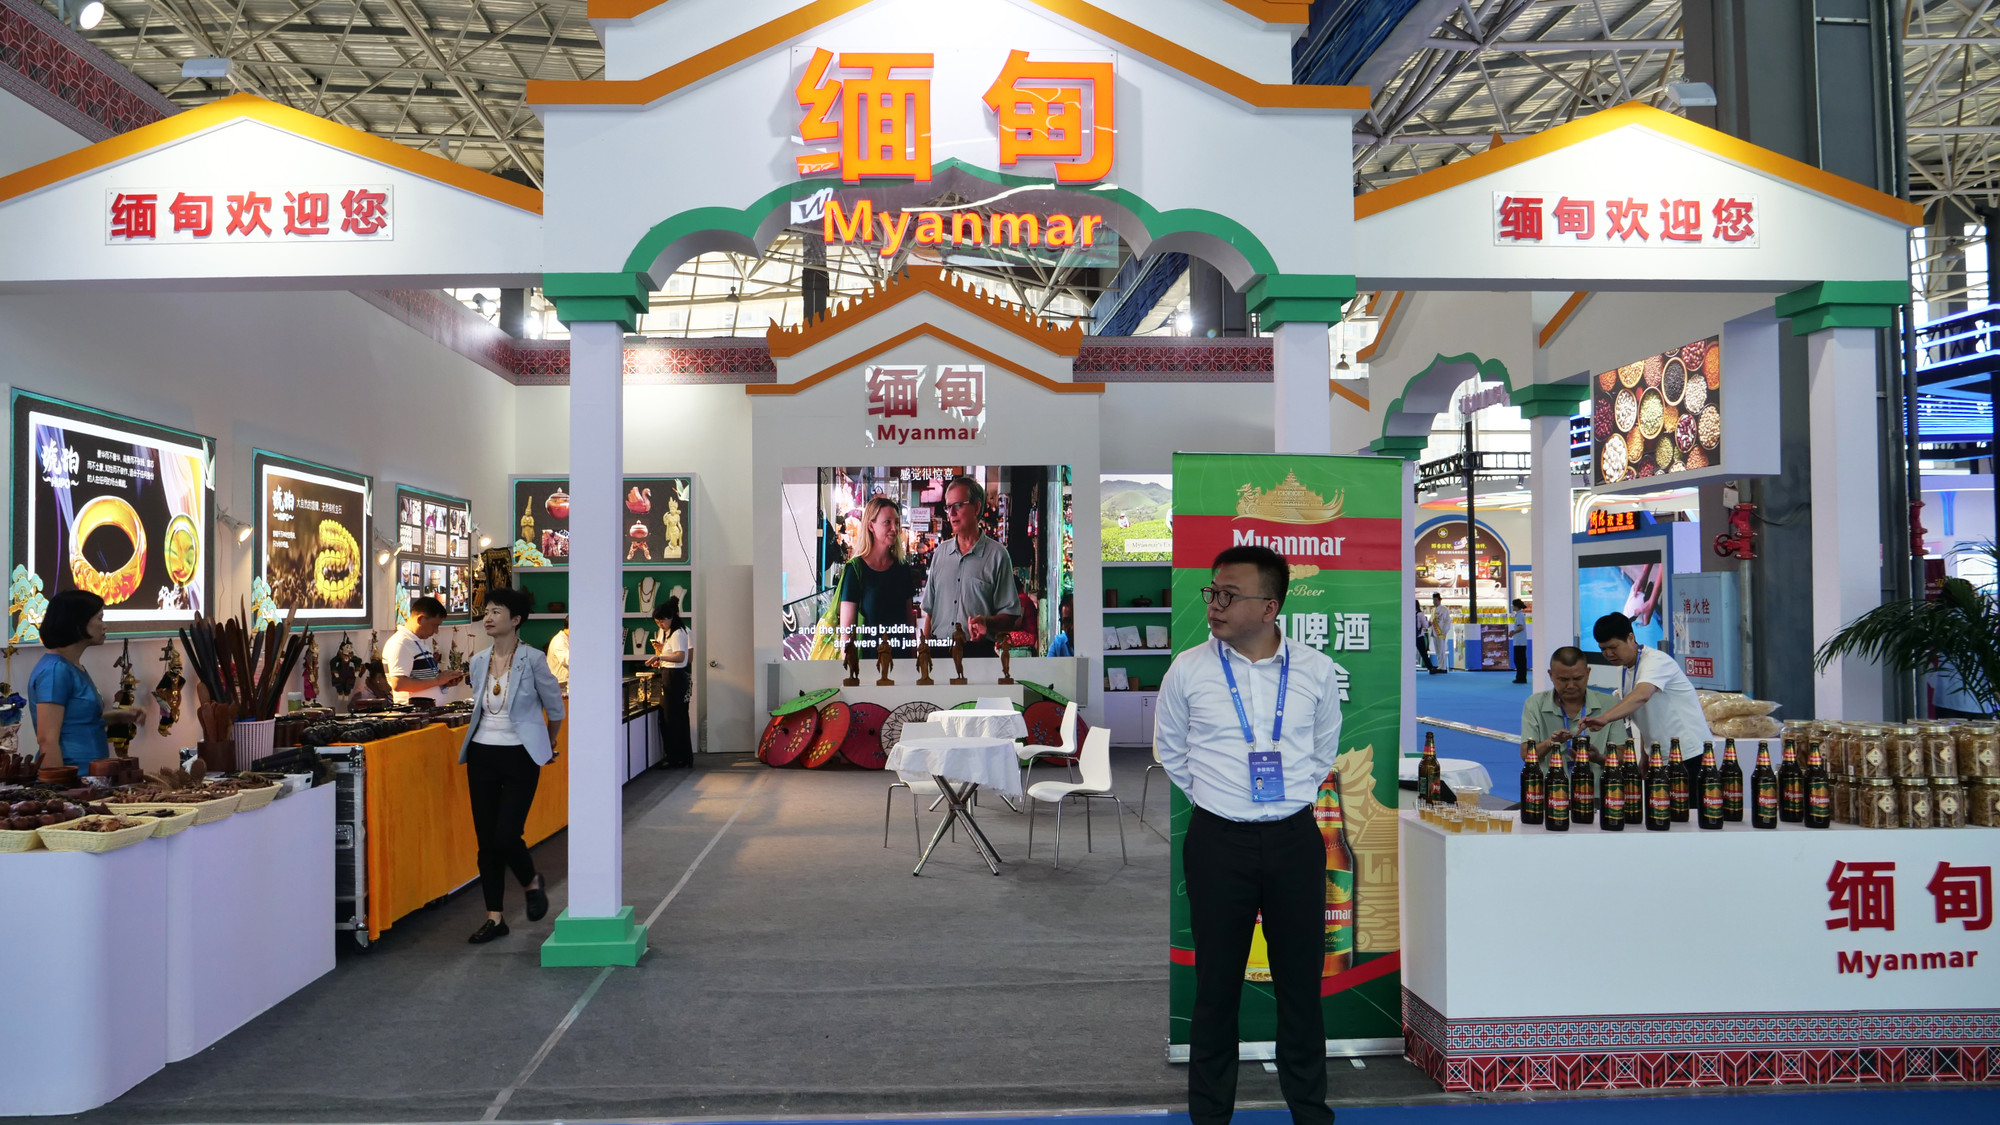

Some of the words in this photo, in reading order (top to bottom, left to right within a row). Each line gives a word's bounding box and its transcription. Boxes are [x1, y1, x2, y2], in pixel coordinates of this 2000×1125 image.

[794, 47, 1115, 184] 缅甸
[111, 189, 387, 239] 缅甸欢迎您
[823, 199, 1102, 258] Myanmar
[1499, 195, 1755, 241] 缅甸欢迎您
[867, 367, 983, 418] 缅甸
[877, 424, 979, 445] Myanmar
[900, 467, 954, 481] 感觉很惊喜
[1293, 584, 1325, 597] Beer
[1683, 598, 1710, 615] 消火栓
[798, 624, 816, 635] and
[818, 624, 834, 635] the
[854, 638, 877, 648] were
[1825, 860, 1993, 931] 缅甸
[1837, 950, 1978, 979] Myanmar
